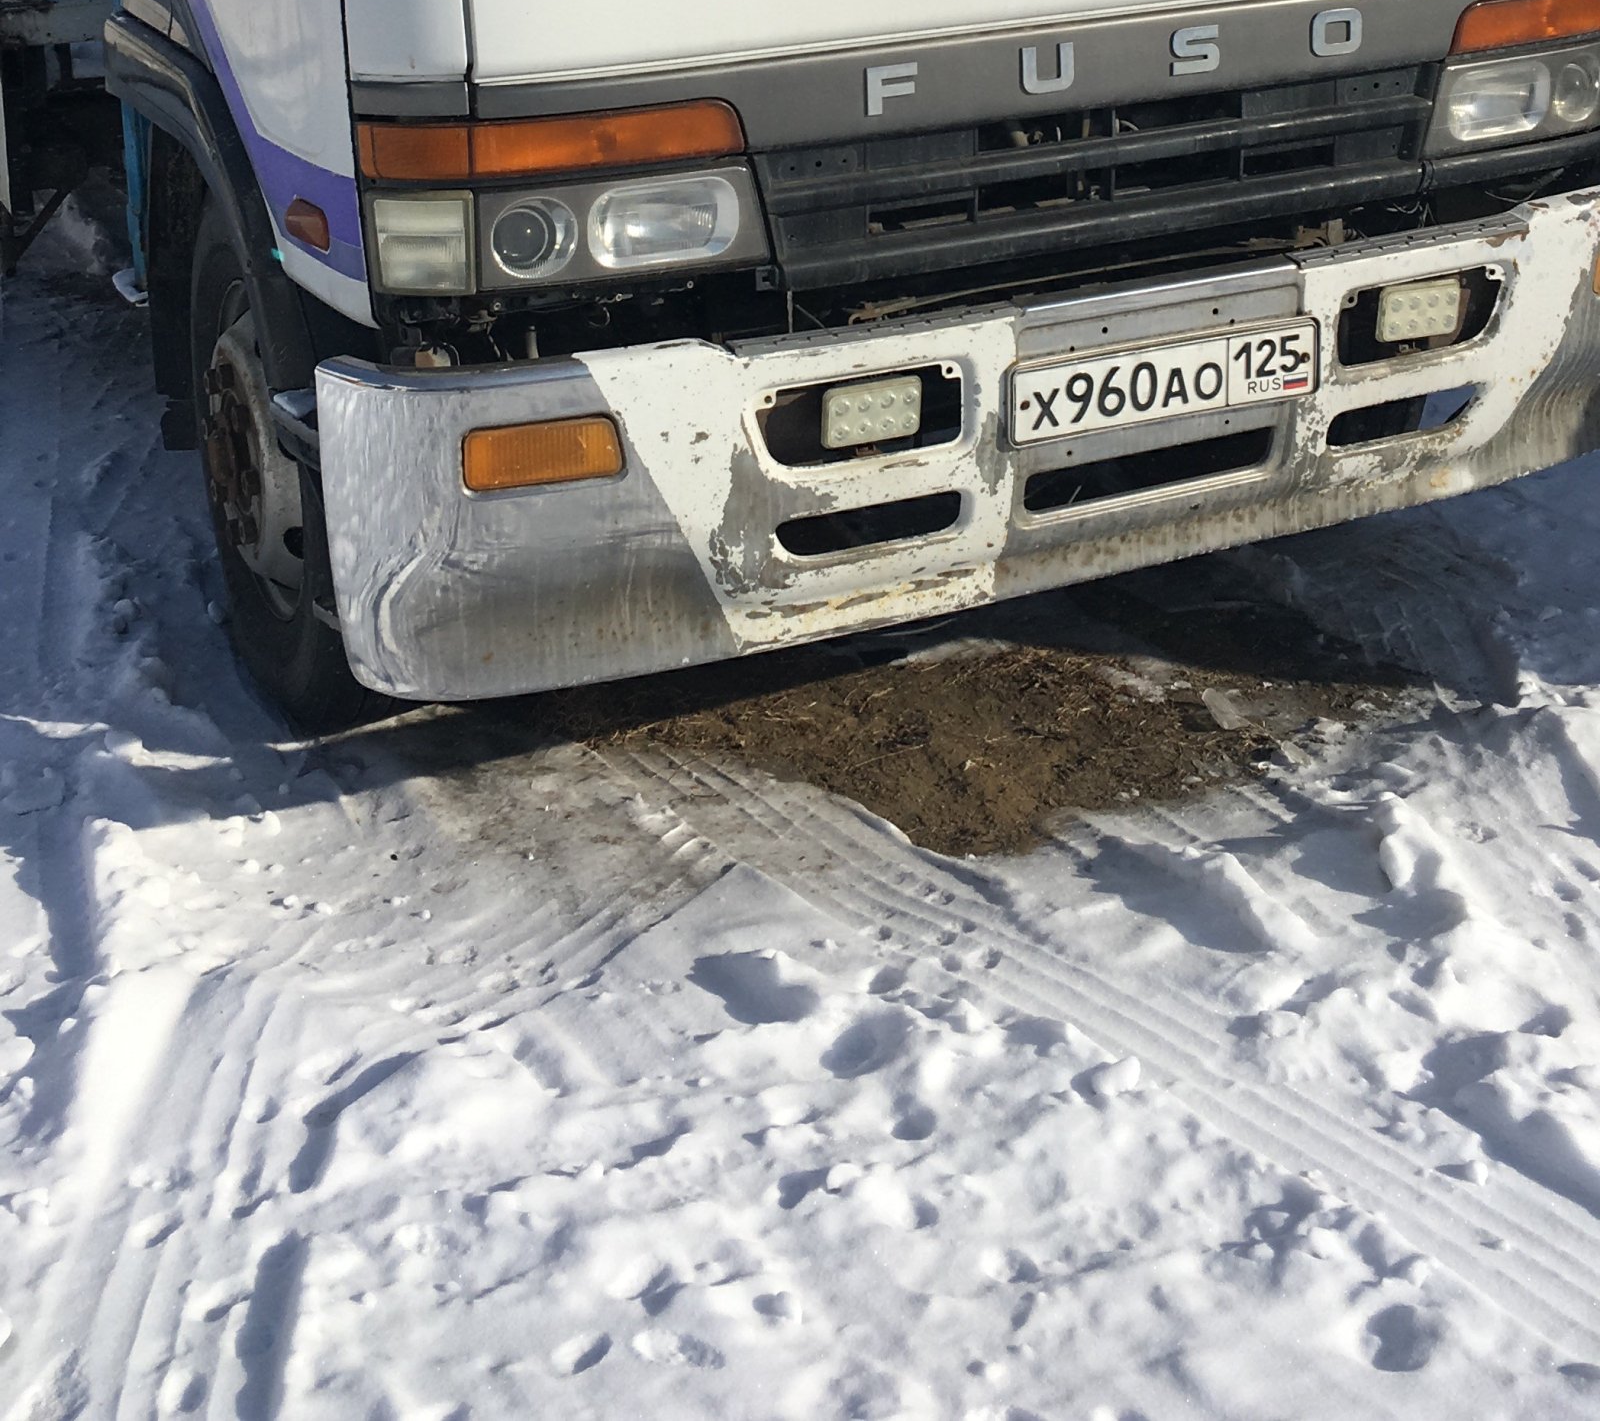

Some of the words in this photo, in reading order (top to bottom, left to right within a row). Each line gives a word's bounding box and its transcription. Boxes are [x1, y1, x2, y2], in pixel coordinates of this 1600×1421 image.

[864, 7, 1362, 116] FUSO
[1233, 334, 1301, 379] 125
[1247, 377, 1281, 394] RUS
